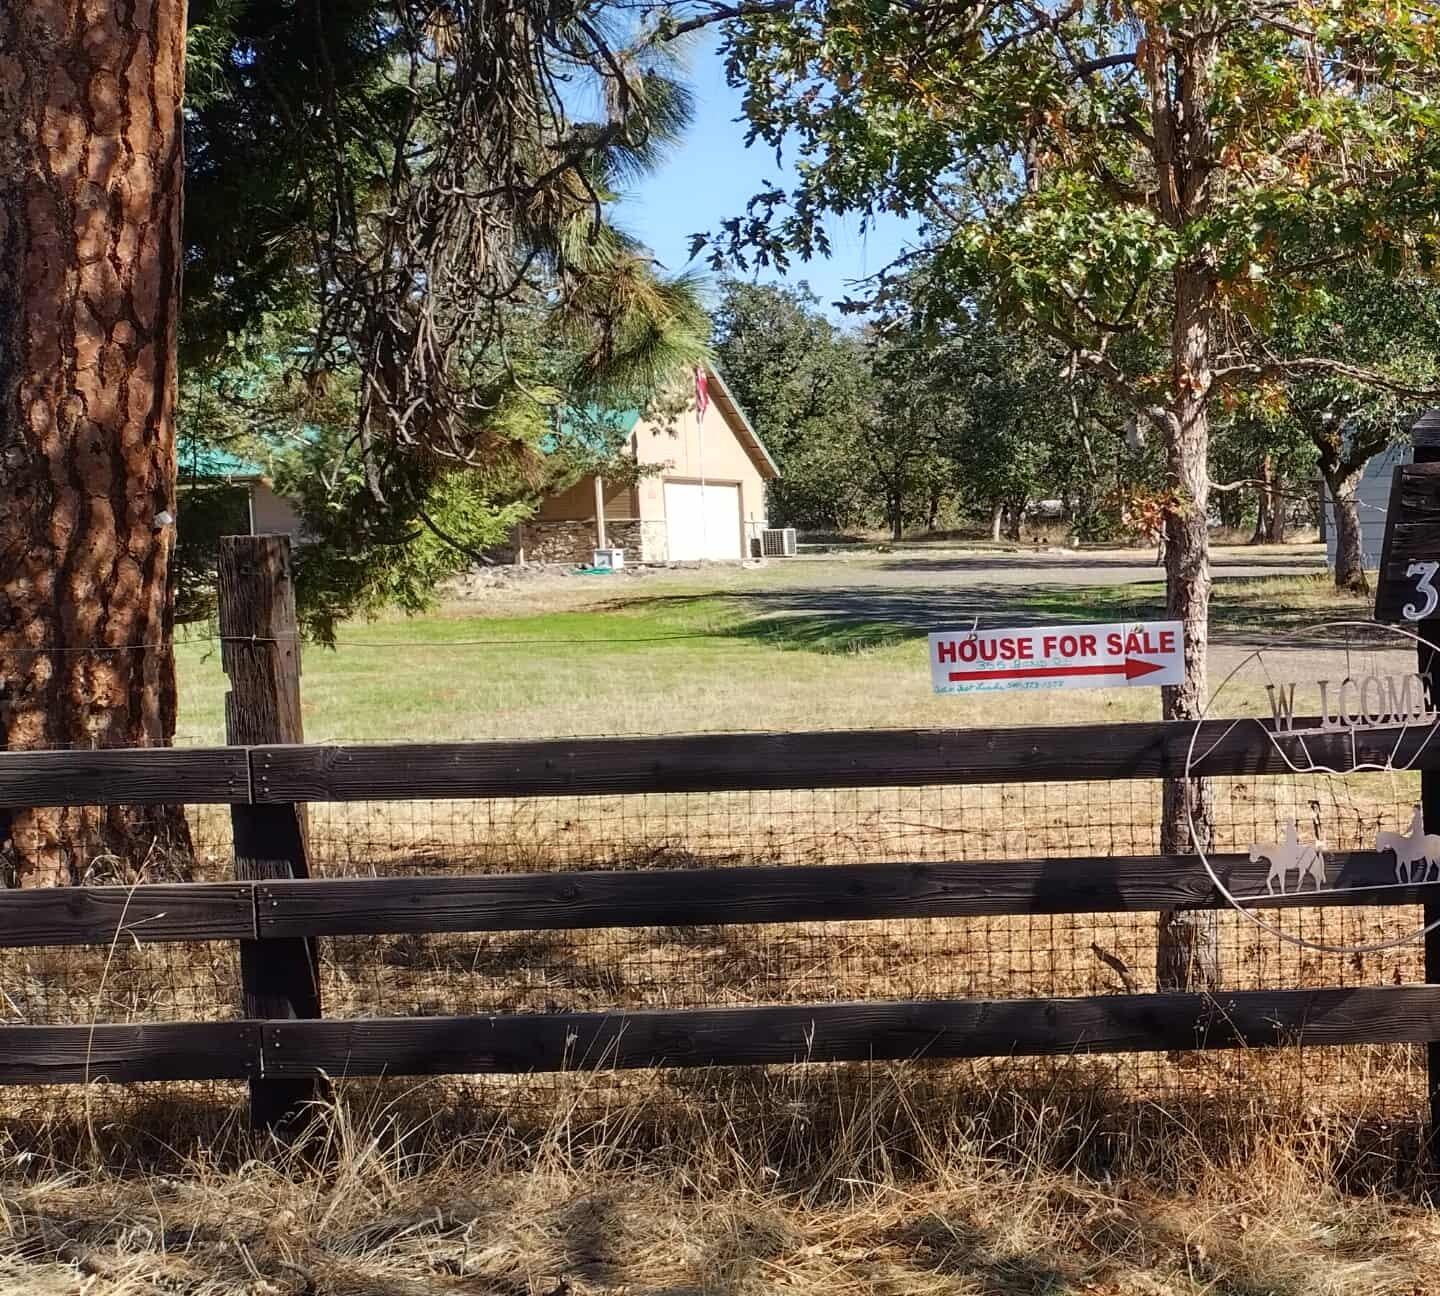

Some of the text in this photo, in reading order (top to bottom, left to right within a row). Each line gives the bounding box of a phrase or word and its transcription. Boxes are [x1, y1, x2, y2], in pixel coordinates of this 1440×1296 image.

[937, 637, 1034, 663] HOUSE
[1042, 634, 1098, 658] FOR
[1106, 630, 1176, 656] SALE
